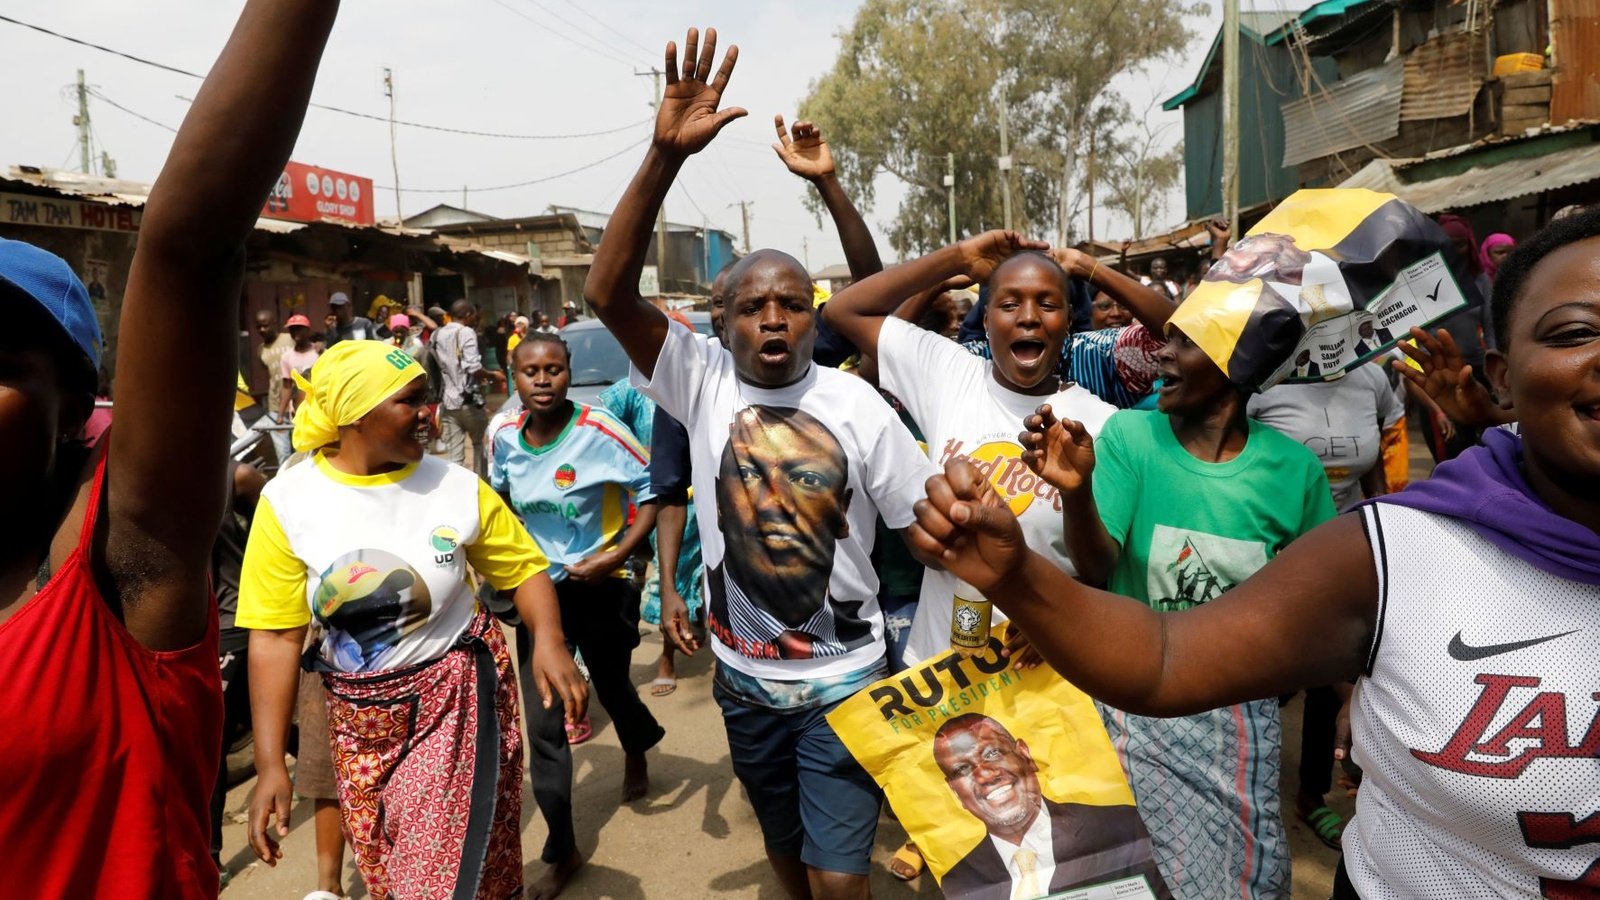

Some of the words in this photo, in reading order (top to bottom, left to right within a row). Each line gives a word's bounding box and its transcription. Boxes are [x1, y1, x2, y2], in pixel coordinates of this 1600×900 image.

[7, 200, 38, 223] TAM
[42, 202, 72, 225] TAM
[80, 203, 140, 231] HOTEL
[316, 200, 338, 214] GLORY
[339, 204, 356, 217] SHOP
[1377, 300, 1404, 319] RIGATHI
[1380, 304, 1418, 328] GACHAGUA
[1319, 338, 1345, 351] WILLIAM
[1323, 359, 1340, 369] RUTO
[1324, 408, 1330, 428] I
[1303, 437, 1360, 457] GET
[889, 714, 923, 734] FOR
[927, 668, 1023, 722] PRESIDENT
